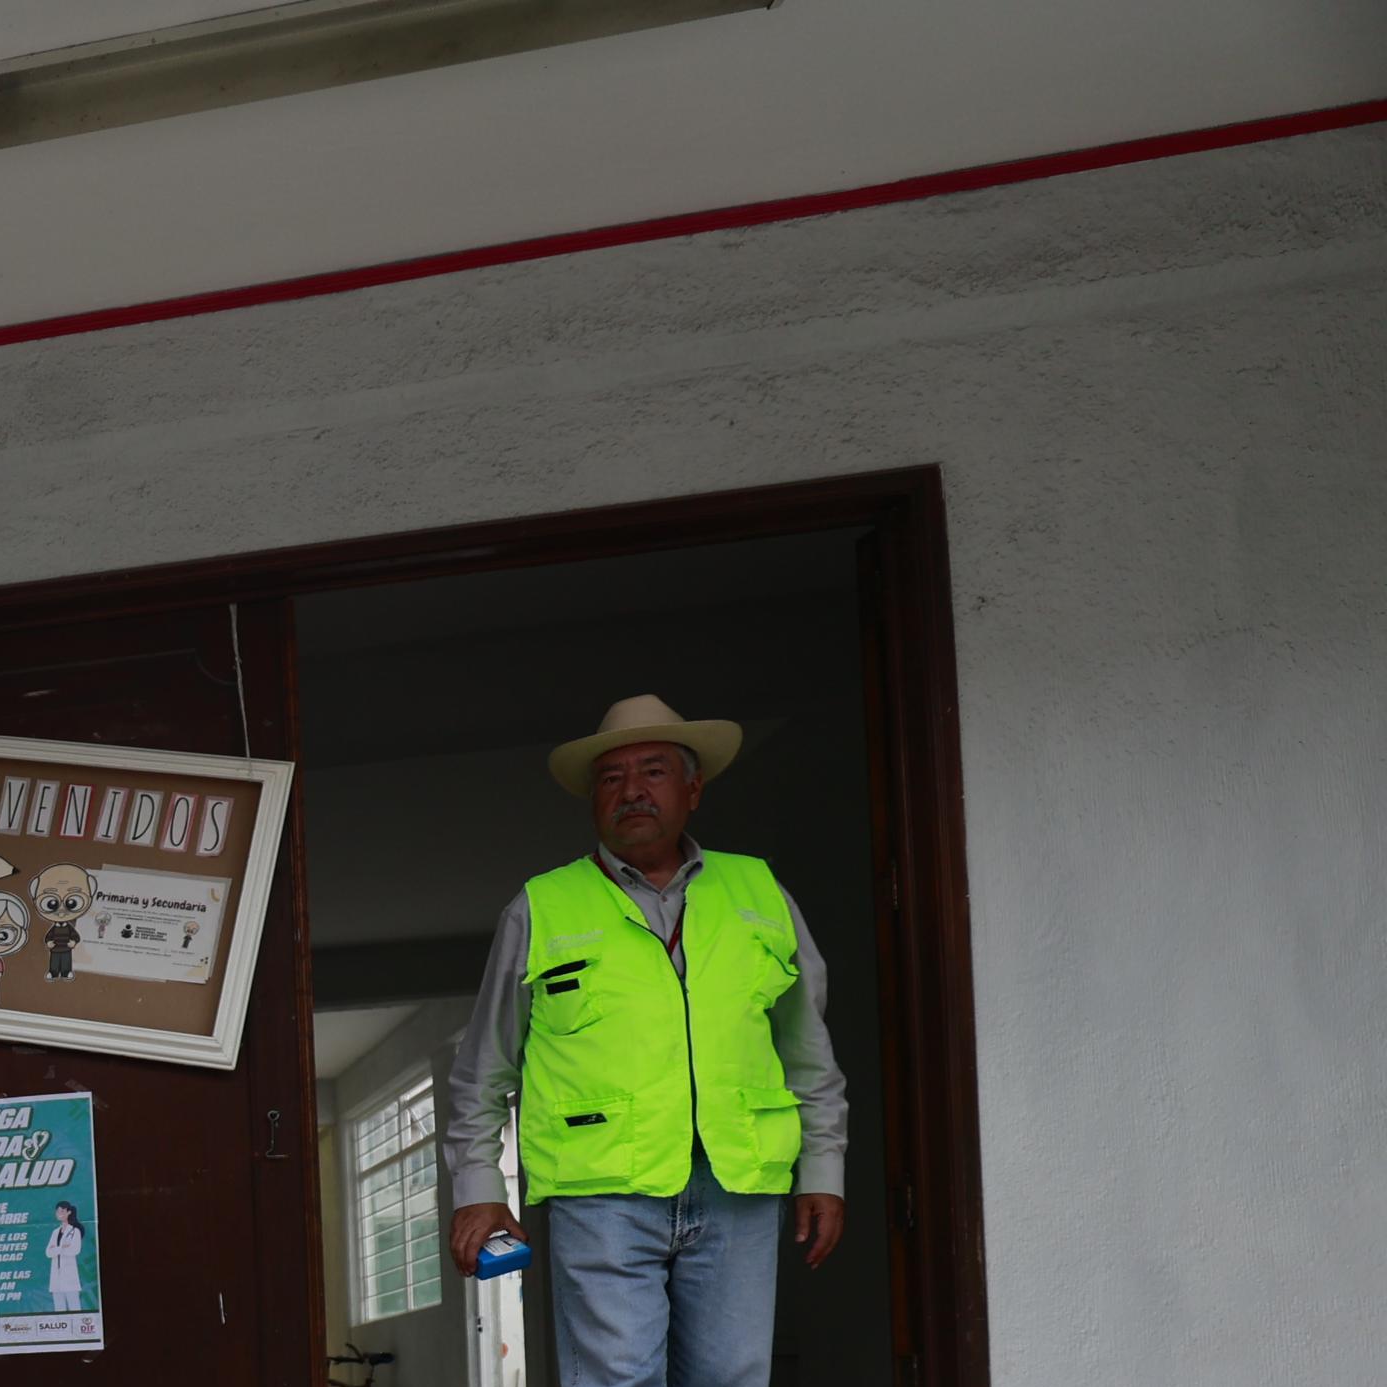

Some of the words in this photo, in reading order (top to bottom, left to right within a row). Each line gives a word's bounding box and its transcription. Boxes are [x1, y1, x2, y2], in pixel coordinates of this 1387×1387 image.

[96, 891, 140, 906] Primaria
[142, 898, 150, 909] y
[152, 897, 208, 913] Secundaria
[8, 1232, 28, 1242] LOS
[0, 1271, 13, 1280] DE
[13, 1270, 32, 1279] LAS
[0, 1281, 16, 1291] AM
[6, 1291, 22, 1301] PM
[39, 1322, 68, 1330] SALUD
[80, 1325, 96, 1333] DIF
